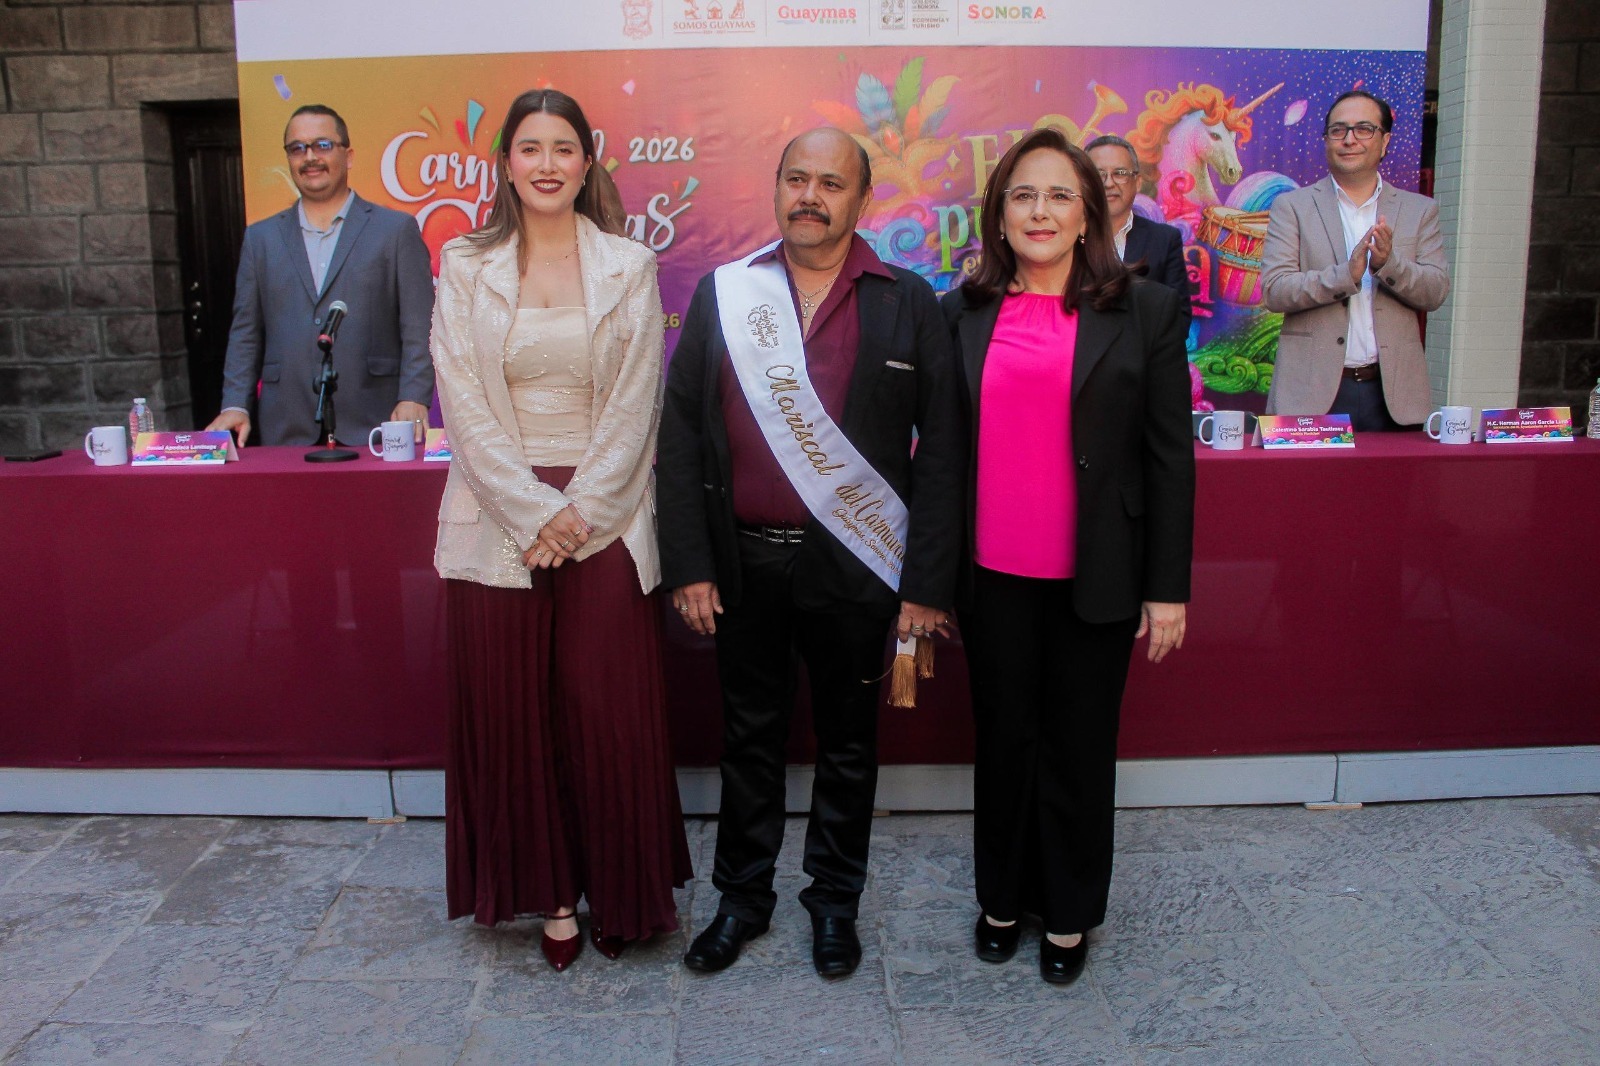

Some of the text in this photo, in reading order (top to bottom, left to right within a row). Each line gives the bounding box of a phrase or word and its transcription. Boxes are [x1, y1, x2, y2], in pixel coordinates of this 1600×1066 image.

[778, 5, 857, 23] Guaymas
[968, 4, 1047, 20] SONORA
[673, 20, 756, 30] SOMOS GUAYMAS
[628, 136, 696, 163] 2026
[765, 364, 905, 564] Mariscal del Carnava
